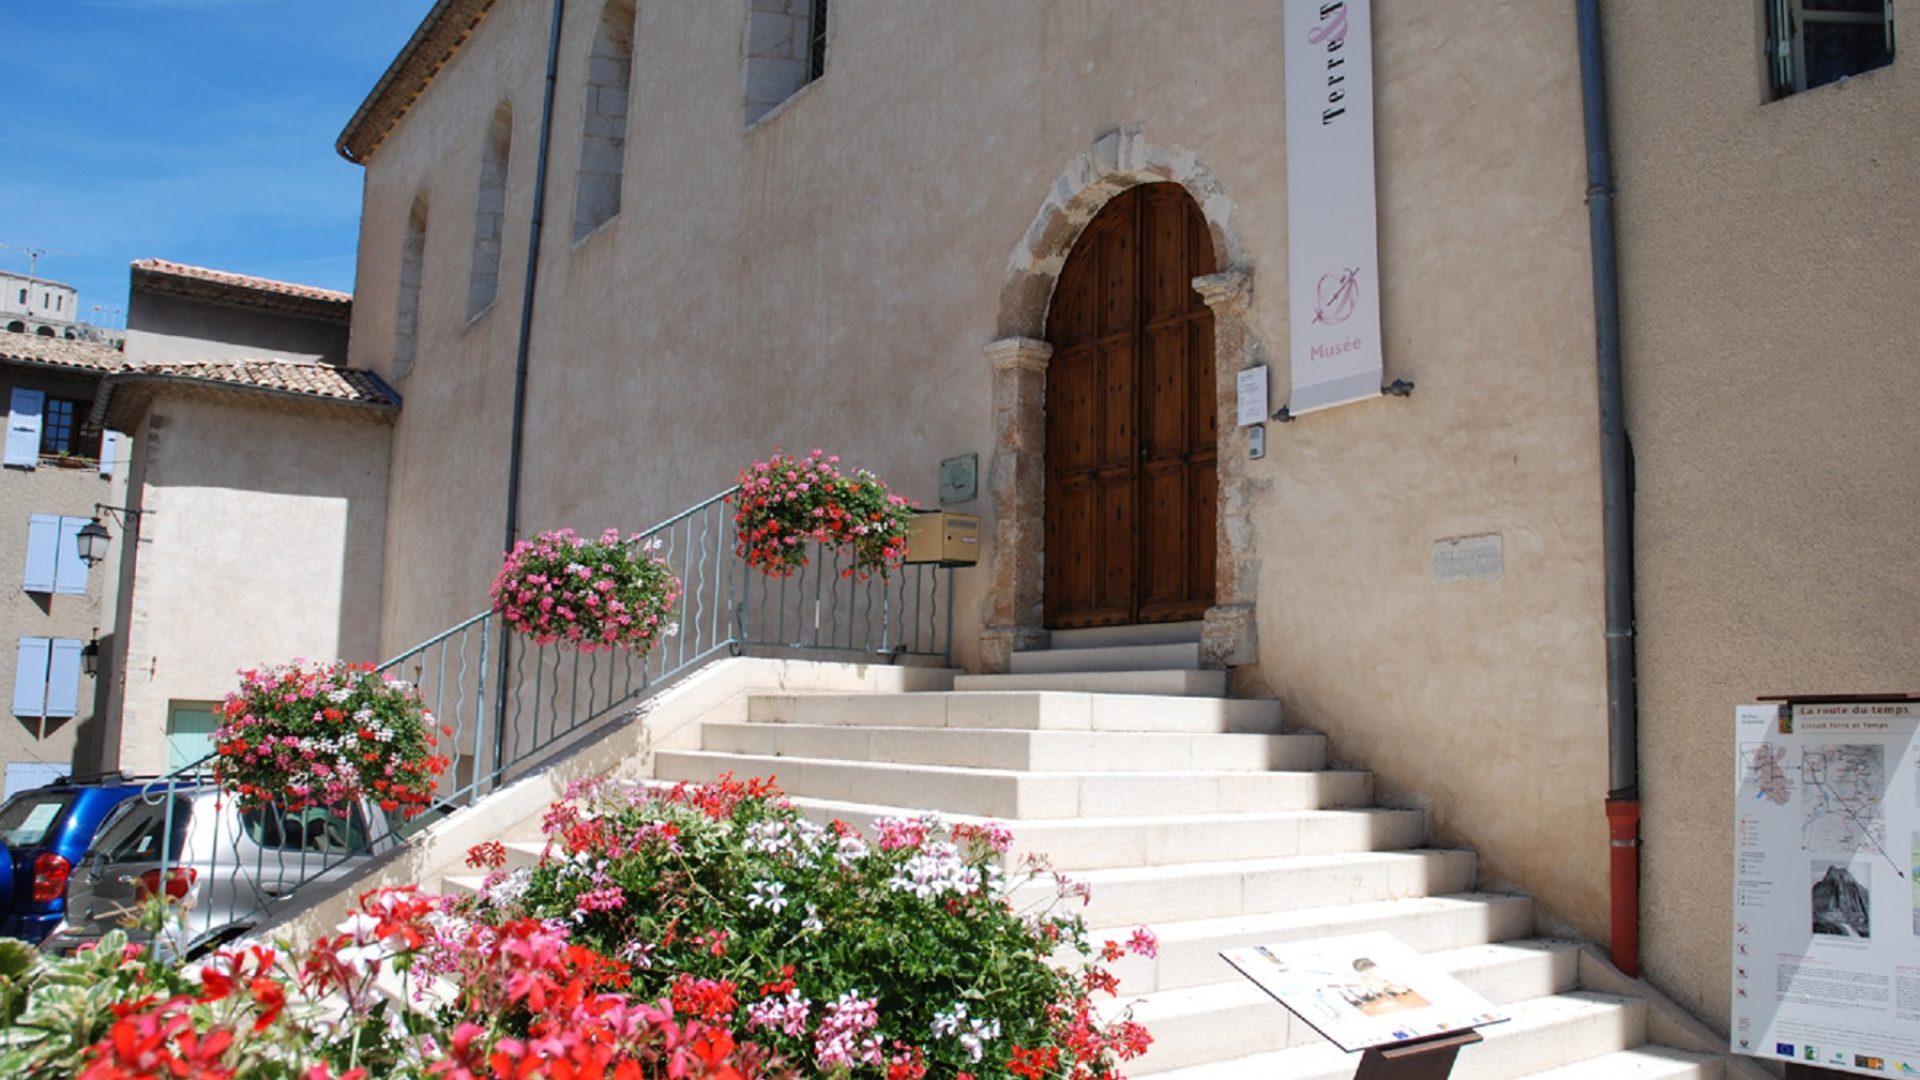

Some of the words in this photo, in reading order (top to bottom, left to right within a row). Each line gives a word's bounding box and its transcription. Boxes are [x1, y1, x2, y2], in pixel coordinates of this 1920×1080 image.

[1310, 336, 1362, 361] Musée
[1800, 706, 1814, 715] La
[1817, 706, 1848, 715] route
[1852, 705, 1868, 715] du
[1871, 705, 1909, 716] temps
[1862, 721, 1889, 730] Temps
